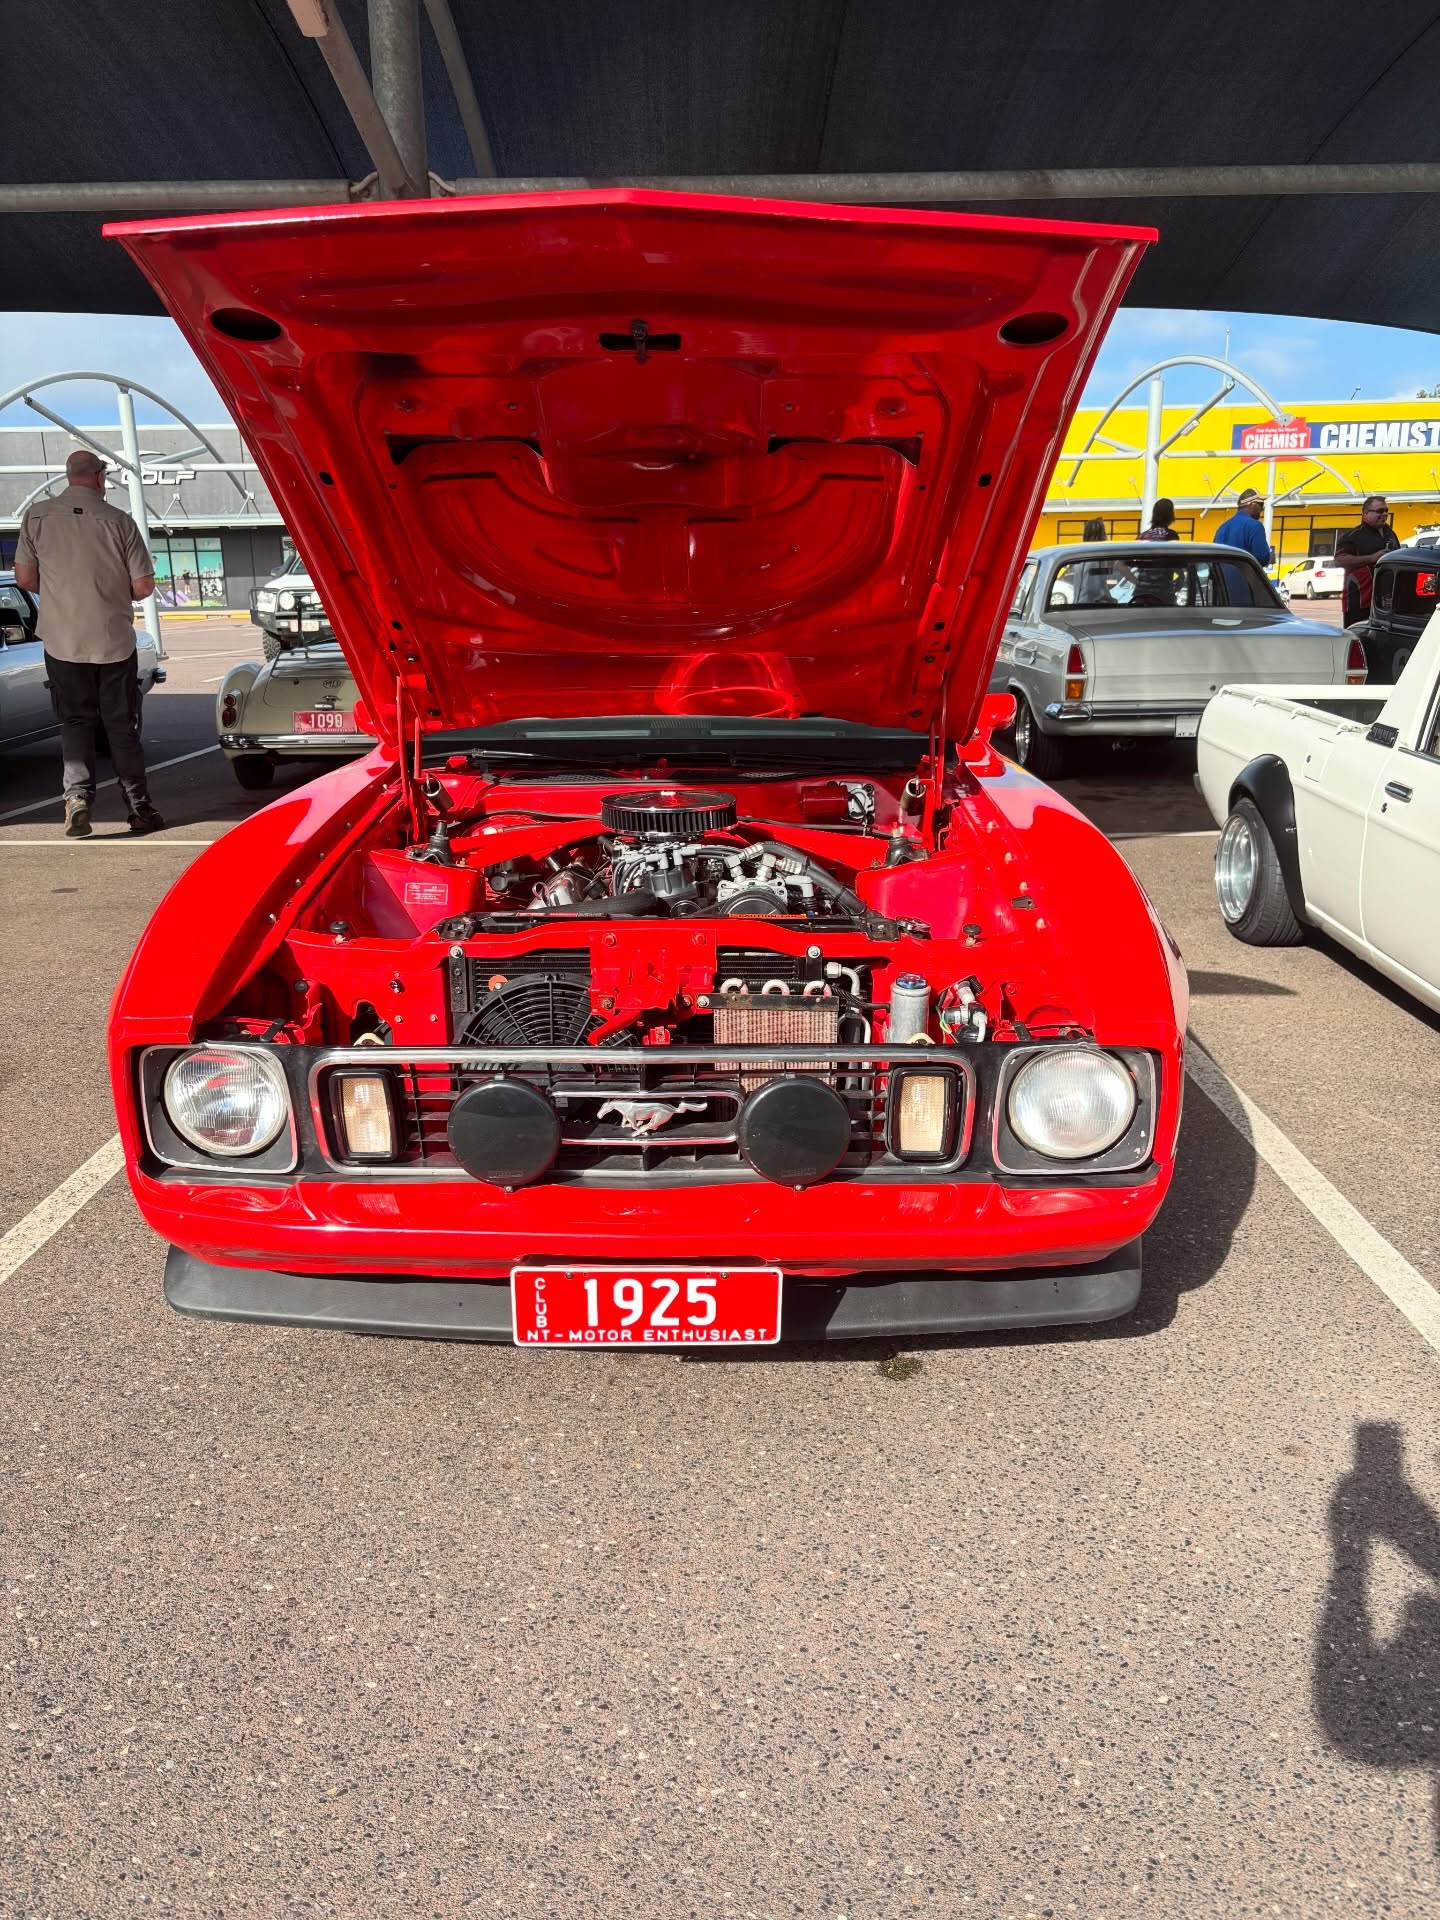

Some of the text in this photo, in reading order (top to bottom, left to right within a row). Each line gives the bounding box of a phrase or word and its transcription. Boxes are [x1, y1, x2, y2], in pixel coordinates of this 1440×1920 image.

[1245, 433, 1307, 449] CHEMIST
[1320, 422, 1440, 449] CHEMIST
[311, 713, 343, 728] 1090
[534, 1277, 548, 1328] CLUB
[584, 1278, 717, 1327] 1925
[643, 1329, 767, 1341] ENTHUSIAST
